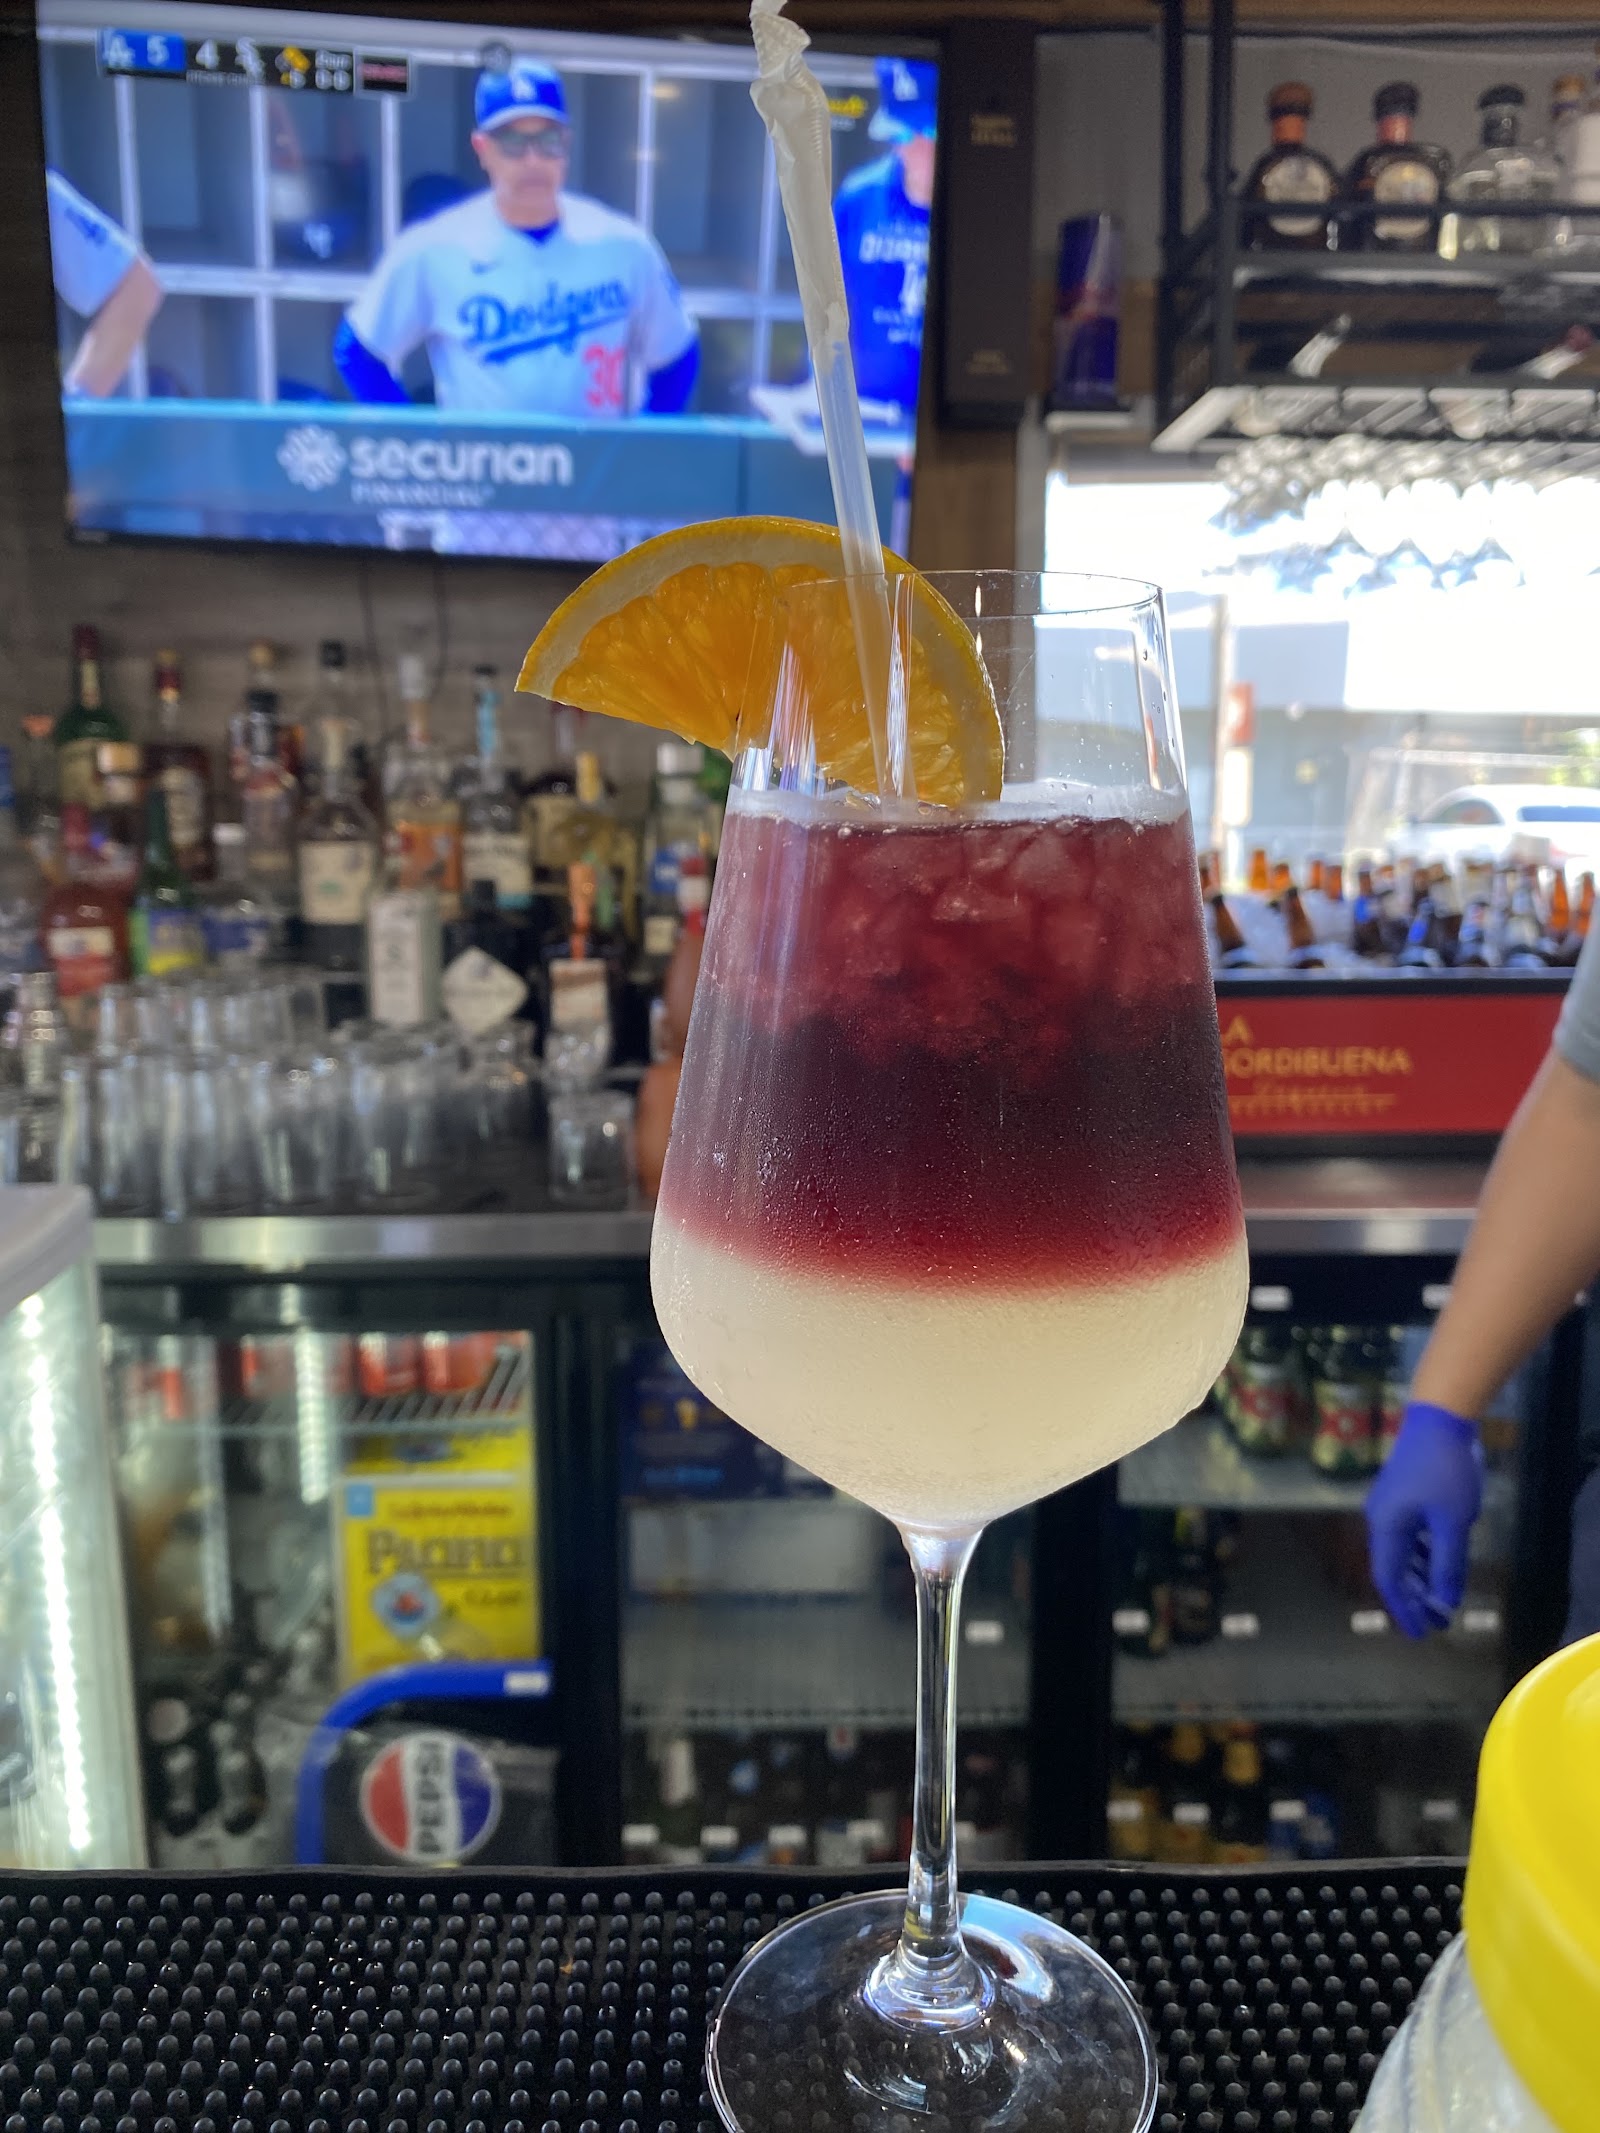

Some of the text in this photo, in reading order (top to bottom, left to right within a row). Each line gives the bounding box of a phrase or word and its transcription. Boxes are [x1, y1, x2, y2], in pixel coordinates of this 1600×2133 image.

[147, 36, 168, 66] 5
[196, 41, 219, 69] 4
[350, 438, 572, 487] securian
[1221, 1015, 1252, 1046] A
[416, 1740, 445, 1855] PEPSI
